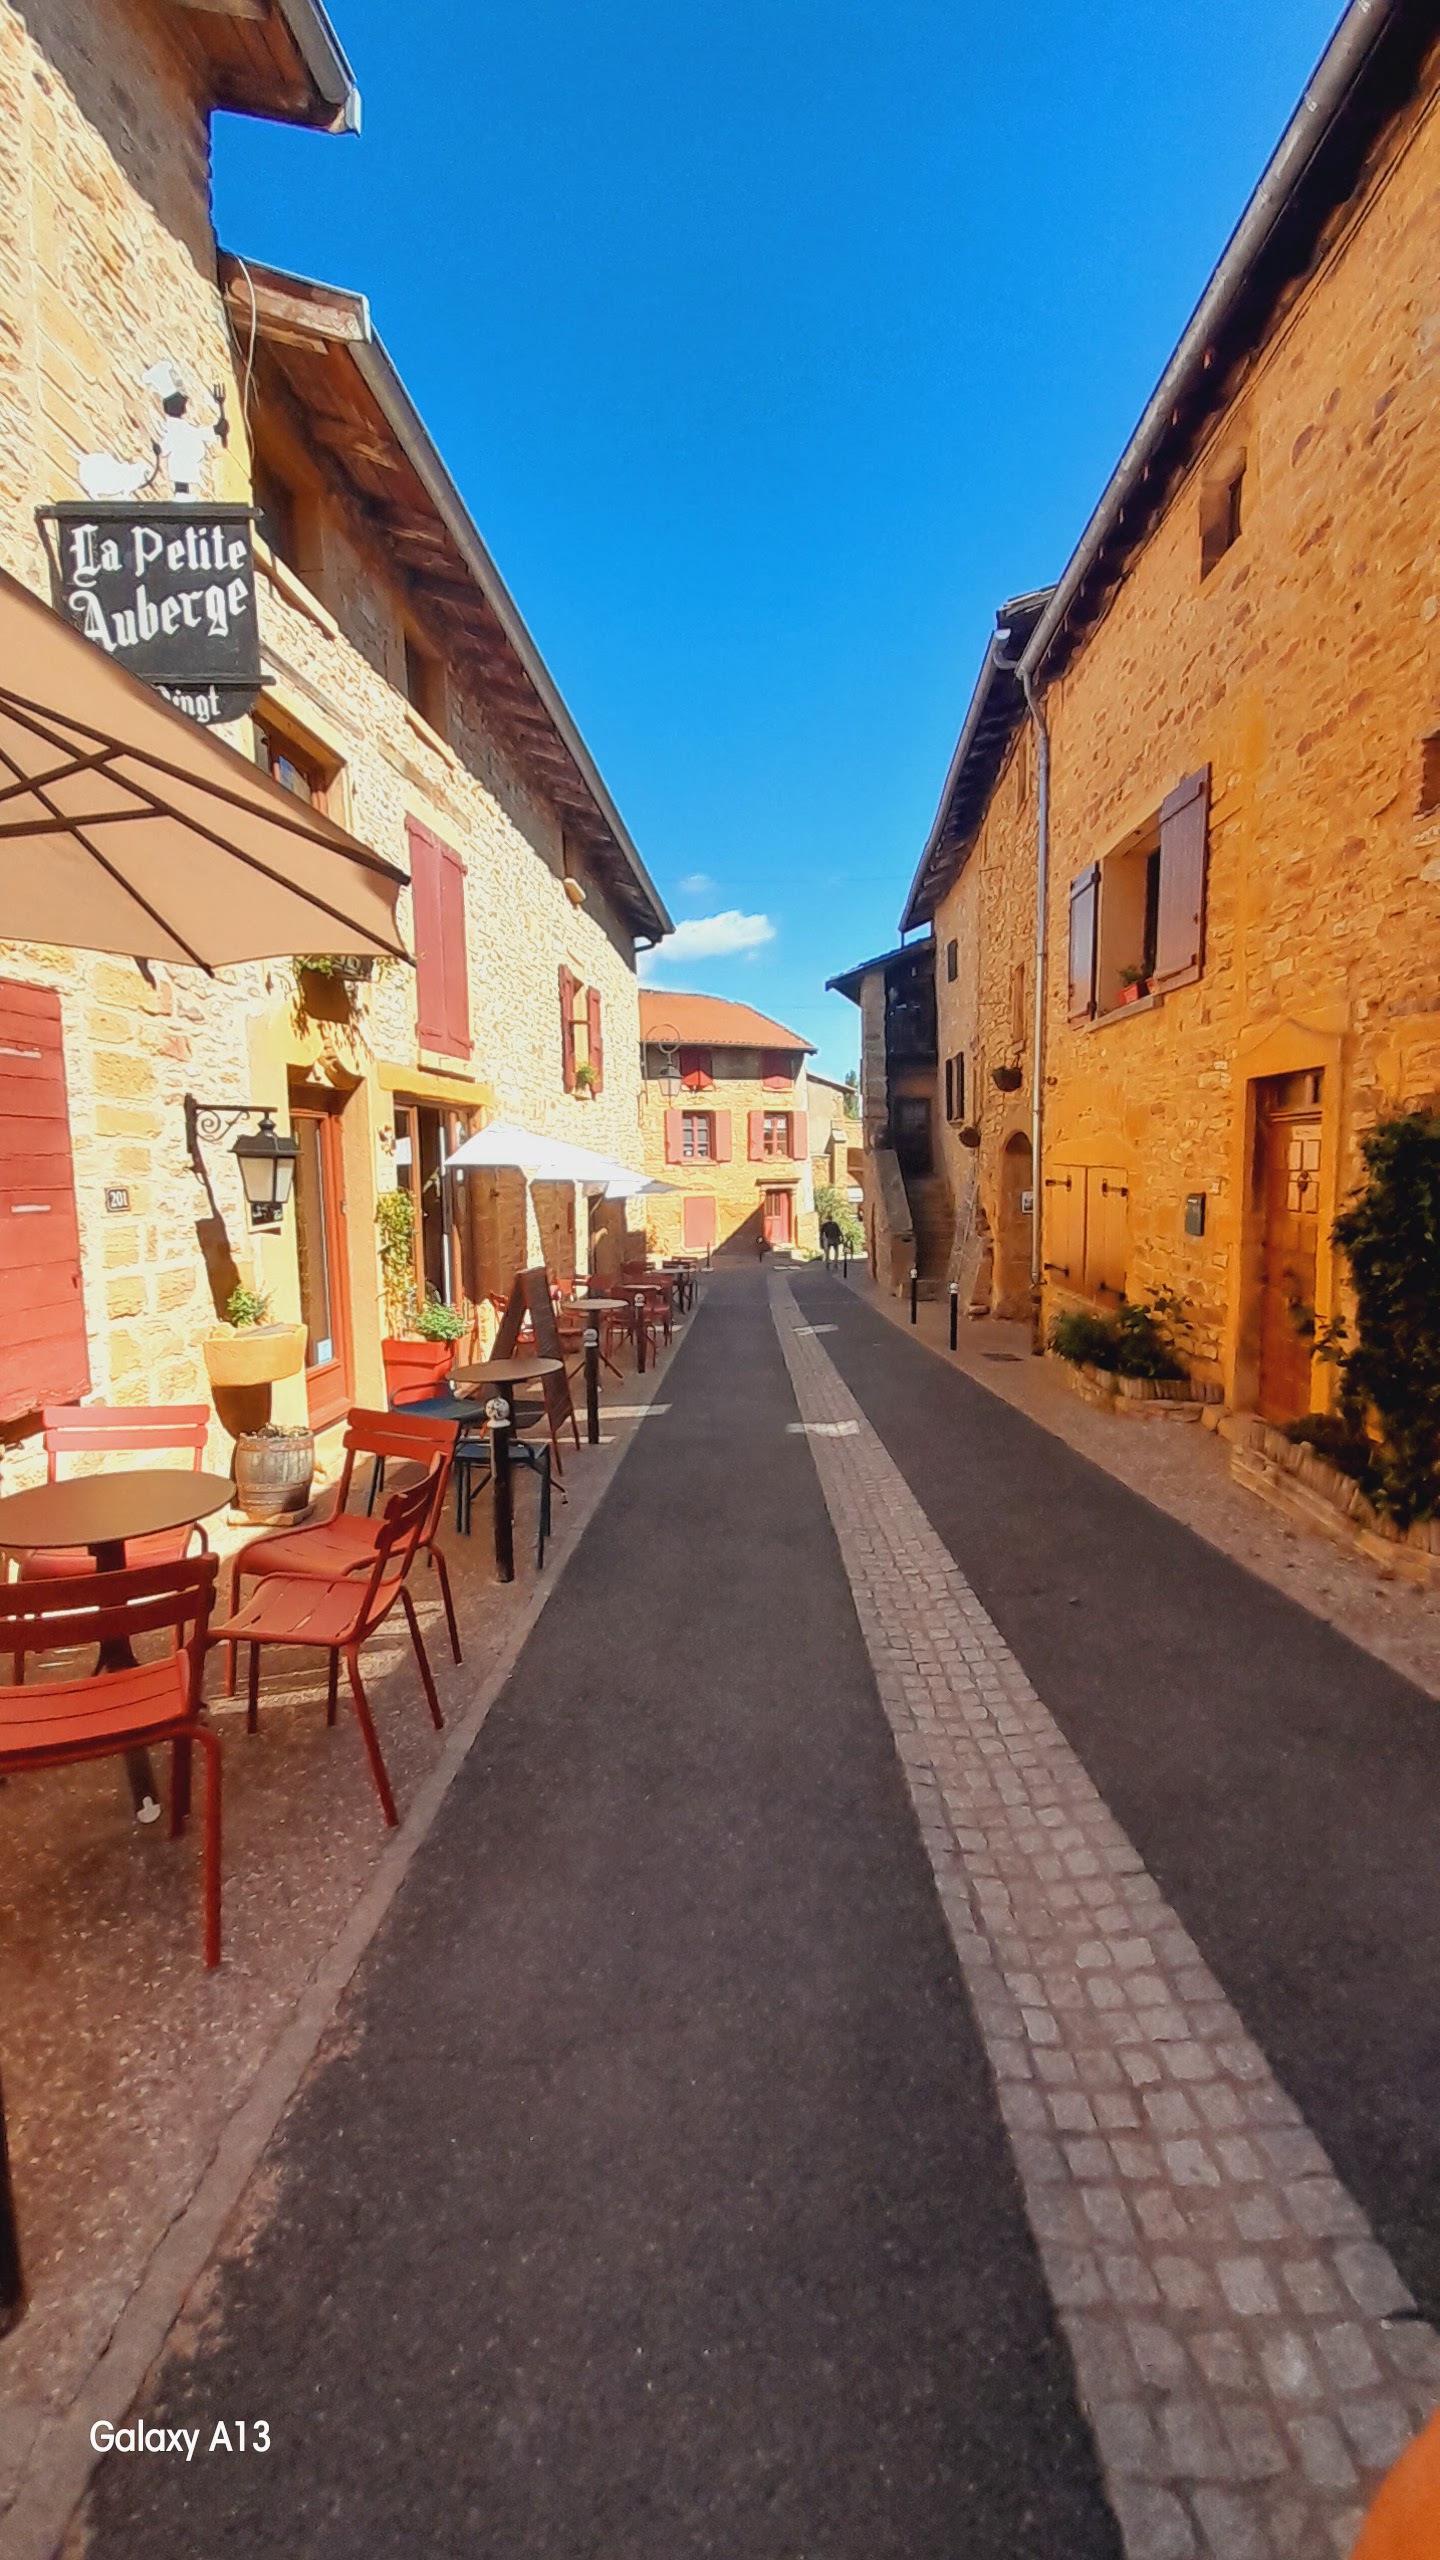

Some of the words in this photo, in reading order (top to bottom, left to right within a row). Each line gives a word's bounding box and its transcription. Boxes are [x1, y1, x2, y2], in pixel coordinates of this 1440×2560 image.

[69, 523, 123, 588] La
[131, 524, 248, 578] Petite
[69, 577, 249, 653] Auberge
[110, 1190, 128, 1207] 201
